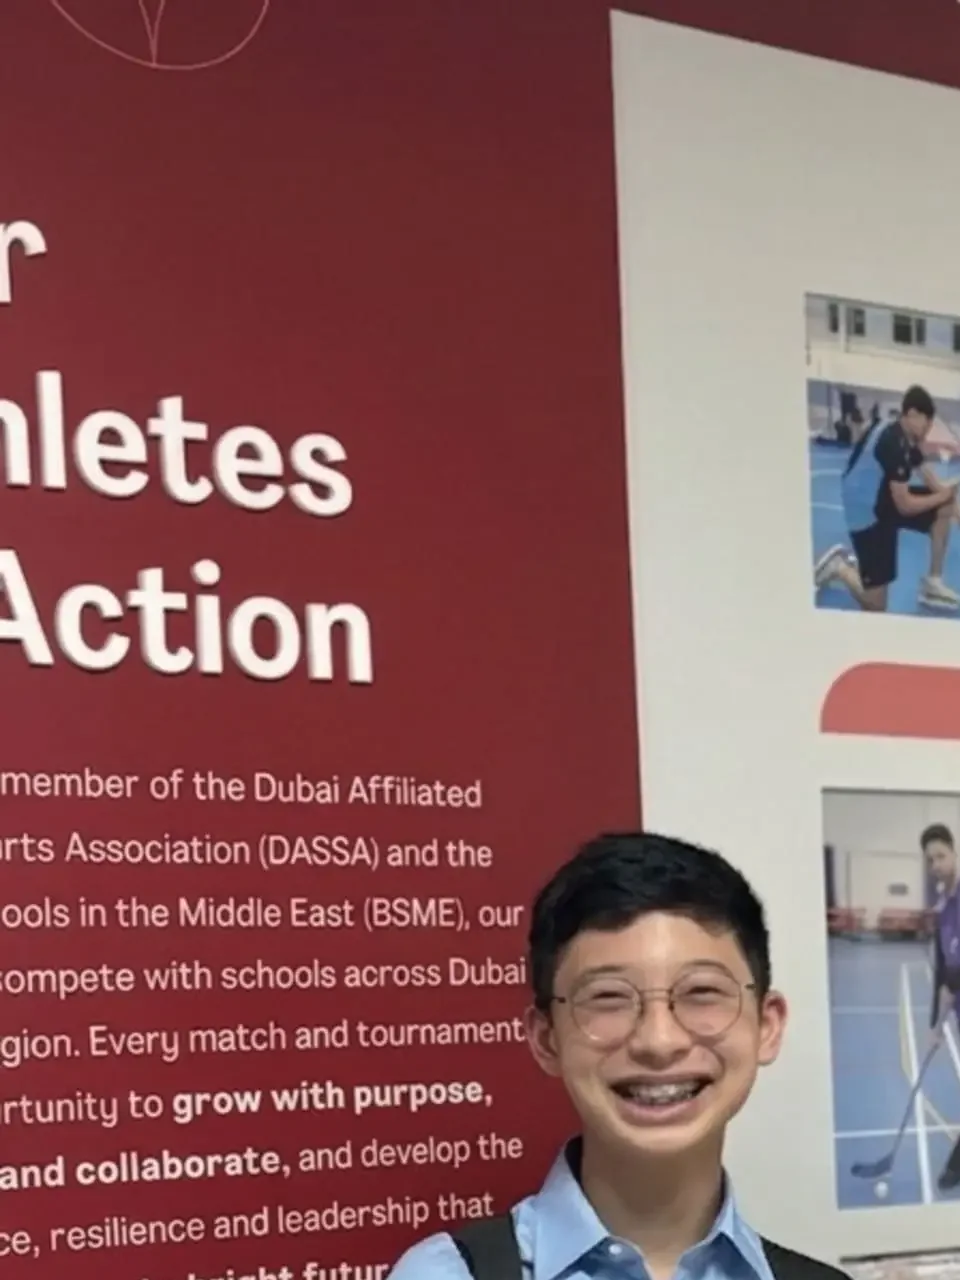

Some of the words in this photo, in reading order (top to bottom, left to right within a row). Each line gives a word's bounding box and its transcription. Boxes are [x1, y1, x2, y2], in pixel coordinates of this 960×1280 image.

[0, 767, 139, 798] member
[149, 768, 184, 800] of
[192, 771, 246, 801] the
[254, 772, 340, 804] Dubai
[348, 775, 482, 808] Affiliated
[0, 833, 55, 862] rts
[65, 831, 250, 864] Association
[259, 835, 379, 870] (DASSA)
[386, 838, 439, 867] and
[445, 839, 493, 868] the
[79, 897, 107, 927] in
[115, 896, 170, 928] the
[179, 897, 282, 927] Middle
[290, 897, 355, 927] East
[364, 897, 470, 931] (BSME),
[478, 905, 525, 927] our
[143, 959, 212, 990] with
[221, 958, 337, 990] schools
[343, 964, 442, 988] across
[448, 957, 526, 986] Dubai
[0, 1028, 80, 1068] gion.
[89, 1025, 179, 1062] Every
[189, 1021, 287, 1052] match
[295, 1019, 349, 1050] and
[356, 1017, 526, 1047] tournament
[3, 1091, 118, 1128] rtunity
[128, 1090, 163, 1118] to
[172, 1090, 262, 1124] grow
[270, 1080, 345, 1111] with
[353, 1081, 492, 1115] purpose,
[0, 1155, 65, 1190] and
[75, 1147, 290, 1185] collaborate,
[298, 1140, 353, 1172] and
[360, 1136, 471, 1168] develop
[477, 1132, 523, 1161] the
[50, 1216, 205, 1251] resilience
[213, 1206, 269, 1239] and
[277, 1196, 430, 1230] leadership
[437, 1192, 494, 1221] that
